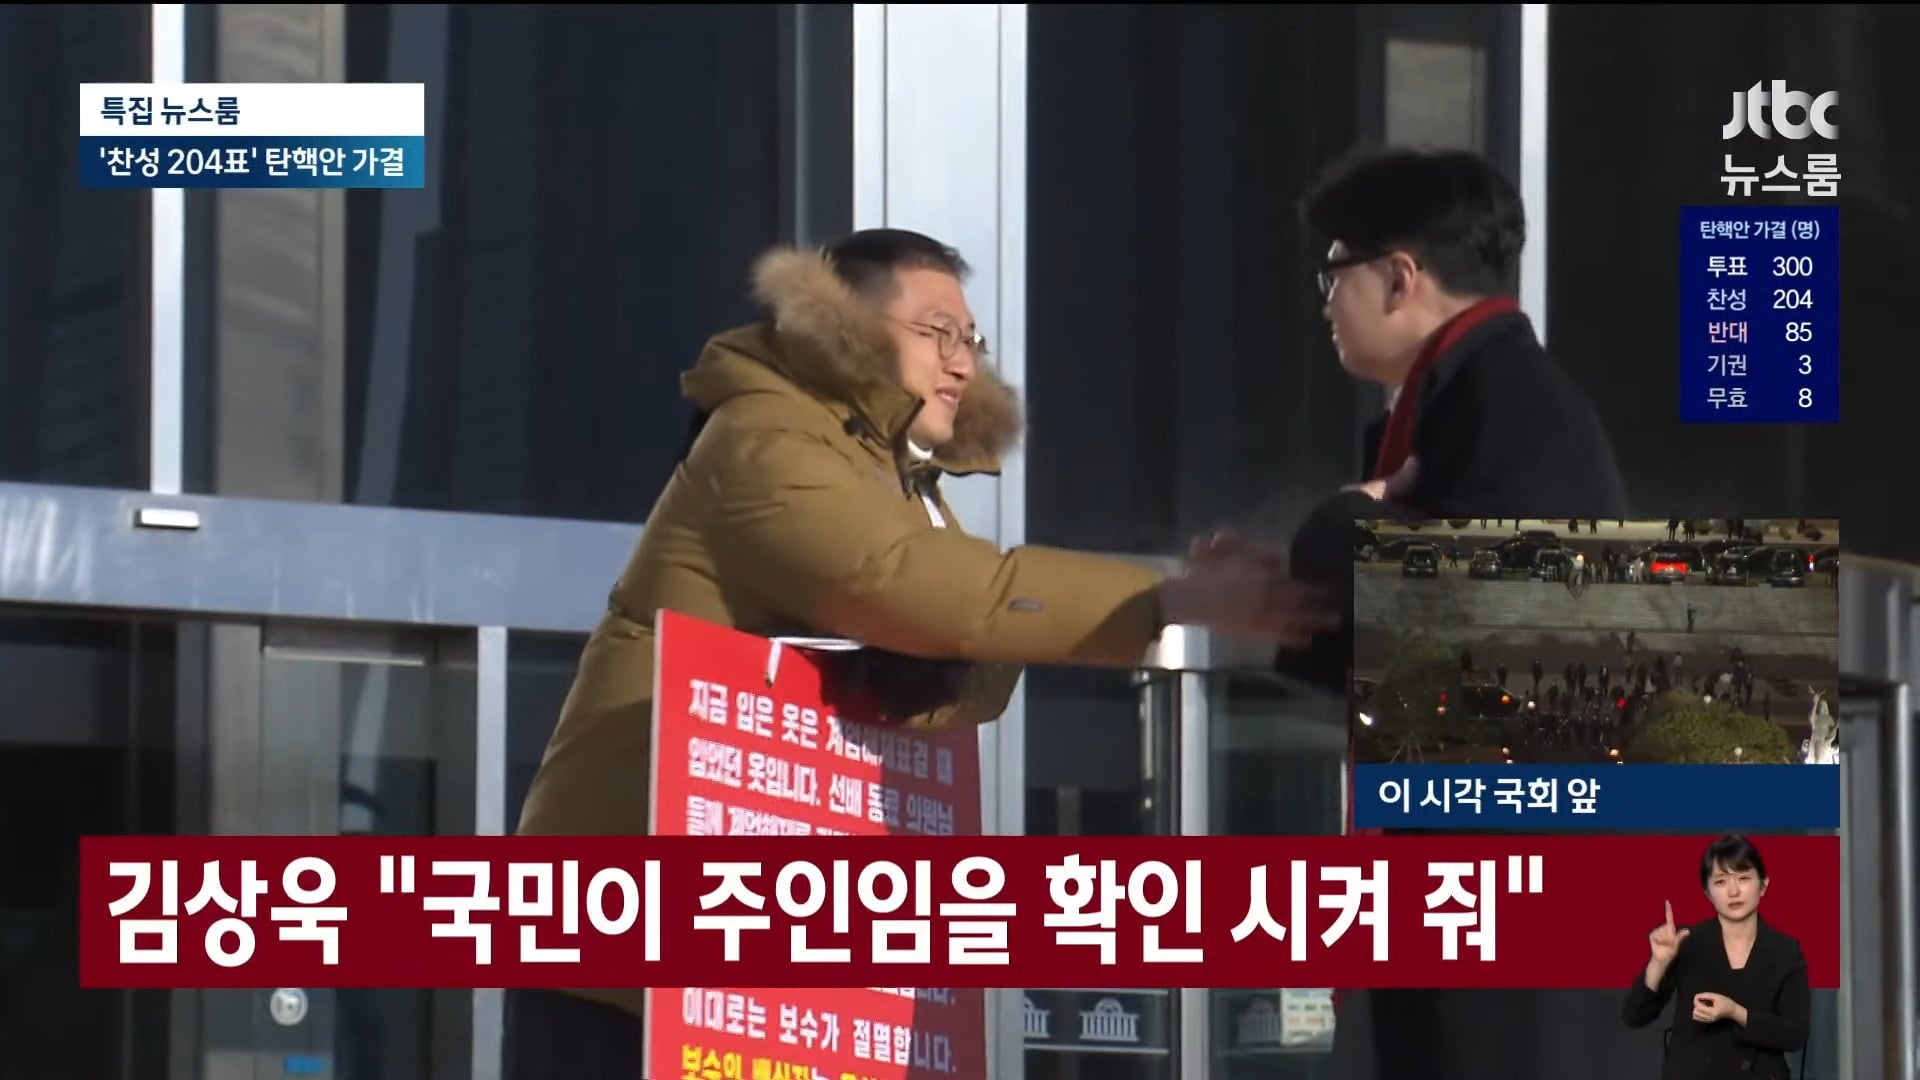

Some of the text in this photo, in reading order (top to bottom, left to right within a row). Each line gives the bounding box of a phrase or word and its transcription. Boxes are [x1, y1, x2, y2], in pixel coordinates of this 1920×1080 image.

[689, 679, 728, 726] 지금
[736, 691, 773, 738] 입은
[782, 703, 818, 750] 옷은
[688, 737, 742, 789] 입었던
[749, 751, 821, 807] 옷입니다.
[829, 771, 862, 818] 선배
[867, 782, 900, 827] 동료
[682, 987, 957, 1074] 이대로는 보수가 절멸합니다.
